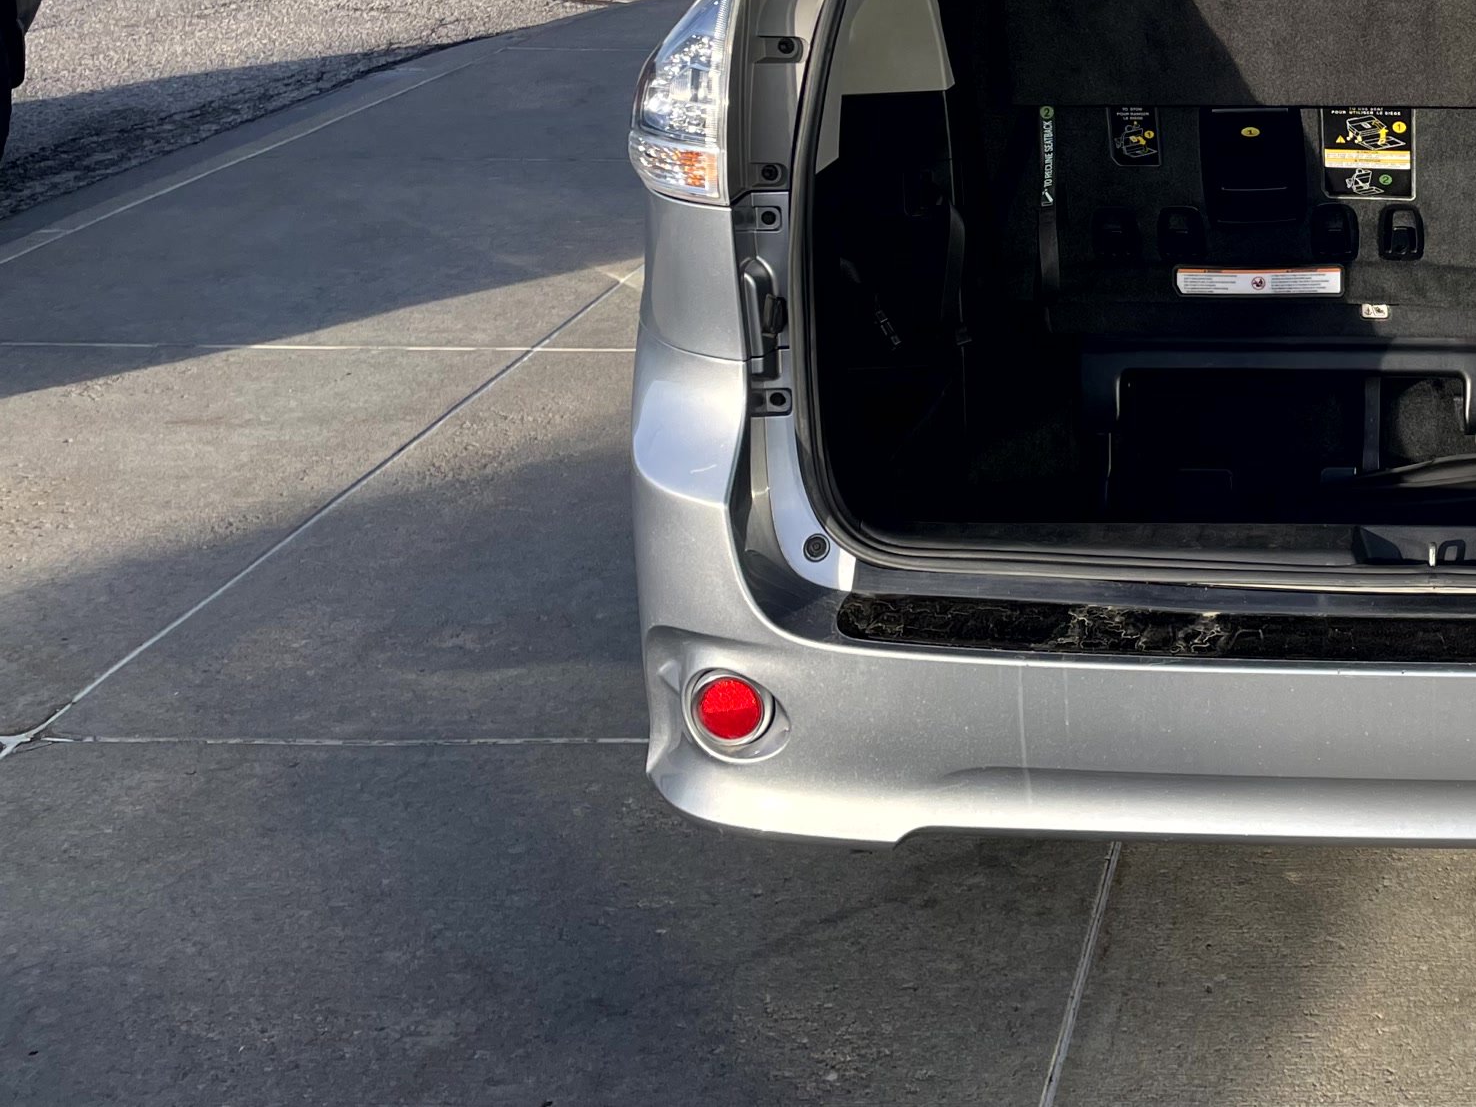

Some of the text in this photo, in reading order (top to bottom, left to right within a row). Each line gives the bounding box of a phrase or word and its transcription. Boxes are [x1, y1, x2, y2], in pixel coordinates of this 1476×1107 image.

[1043, 120, 1054, 188] TO RECLINE SEATBACK
